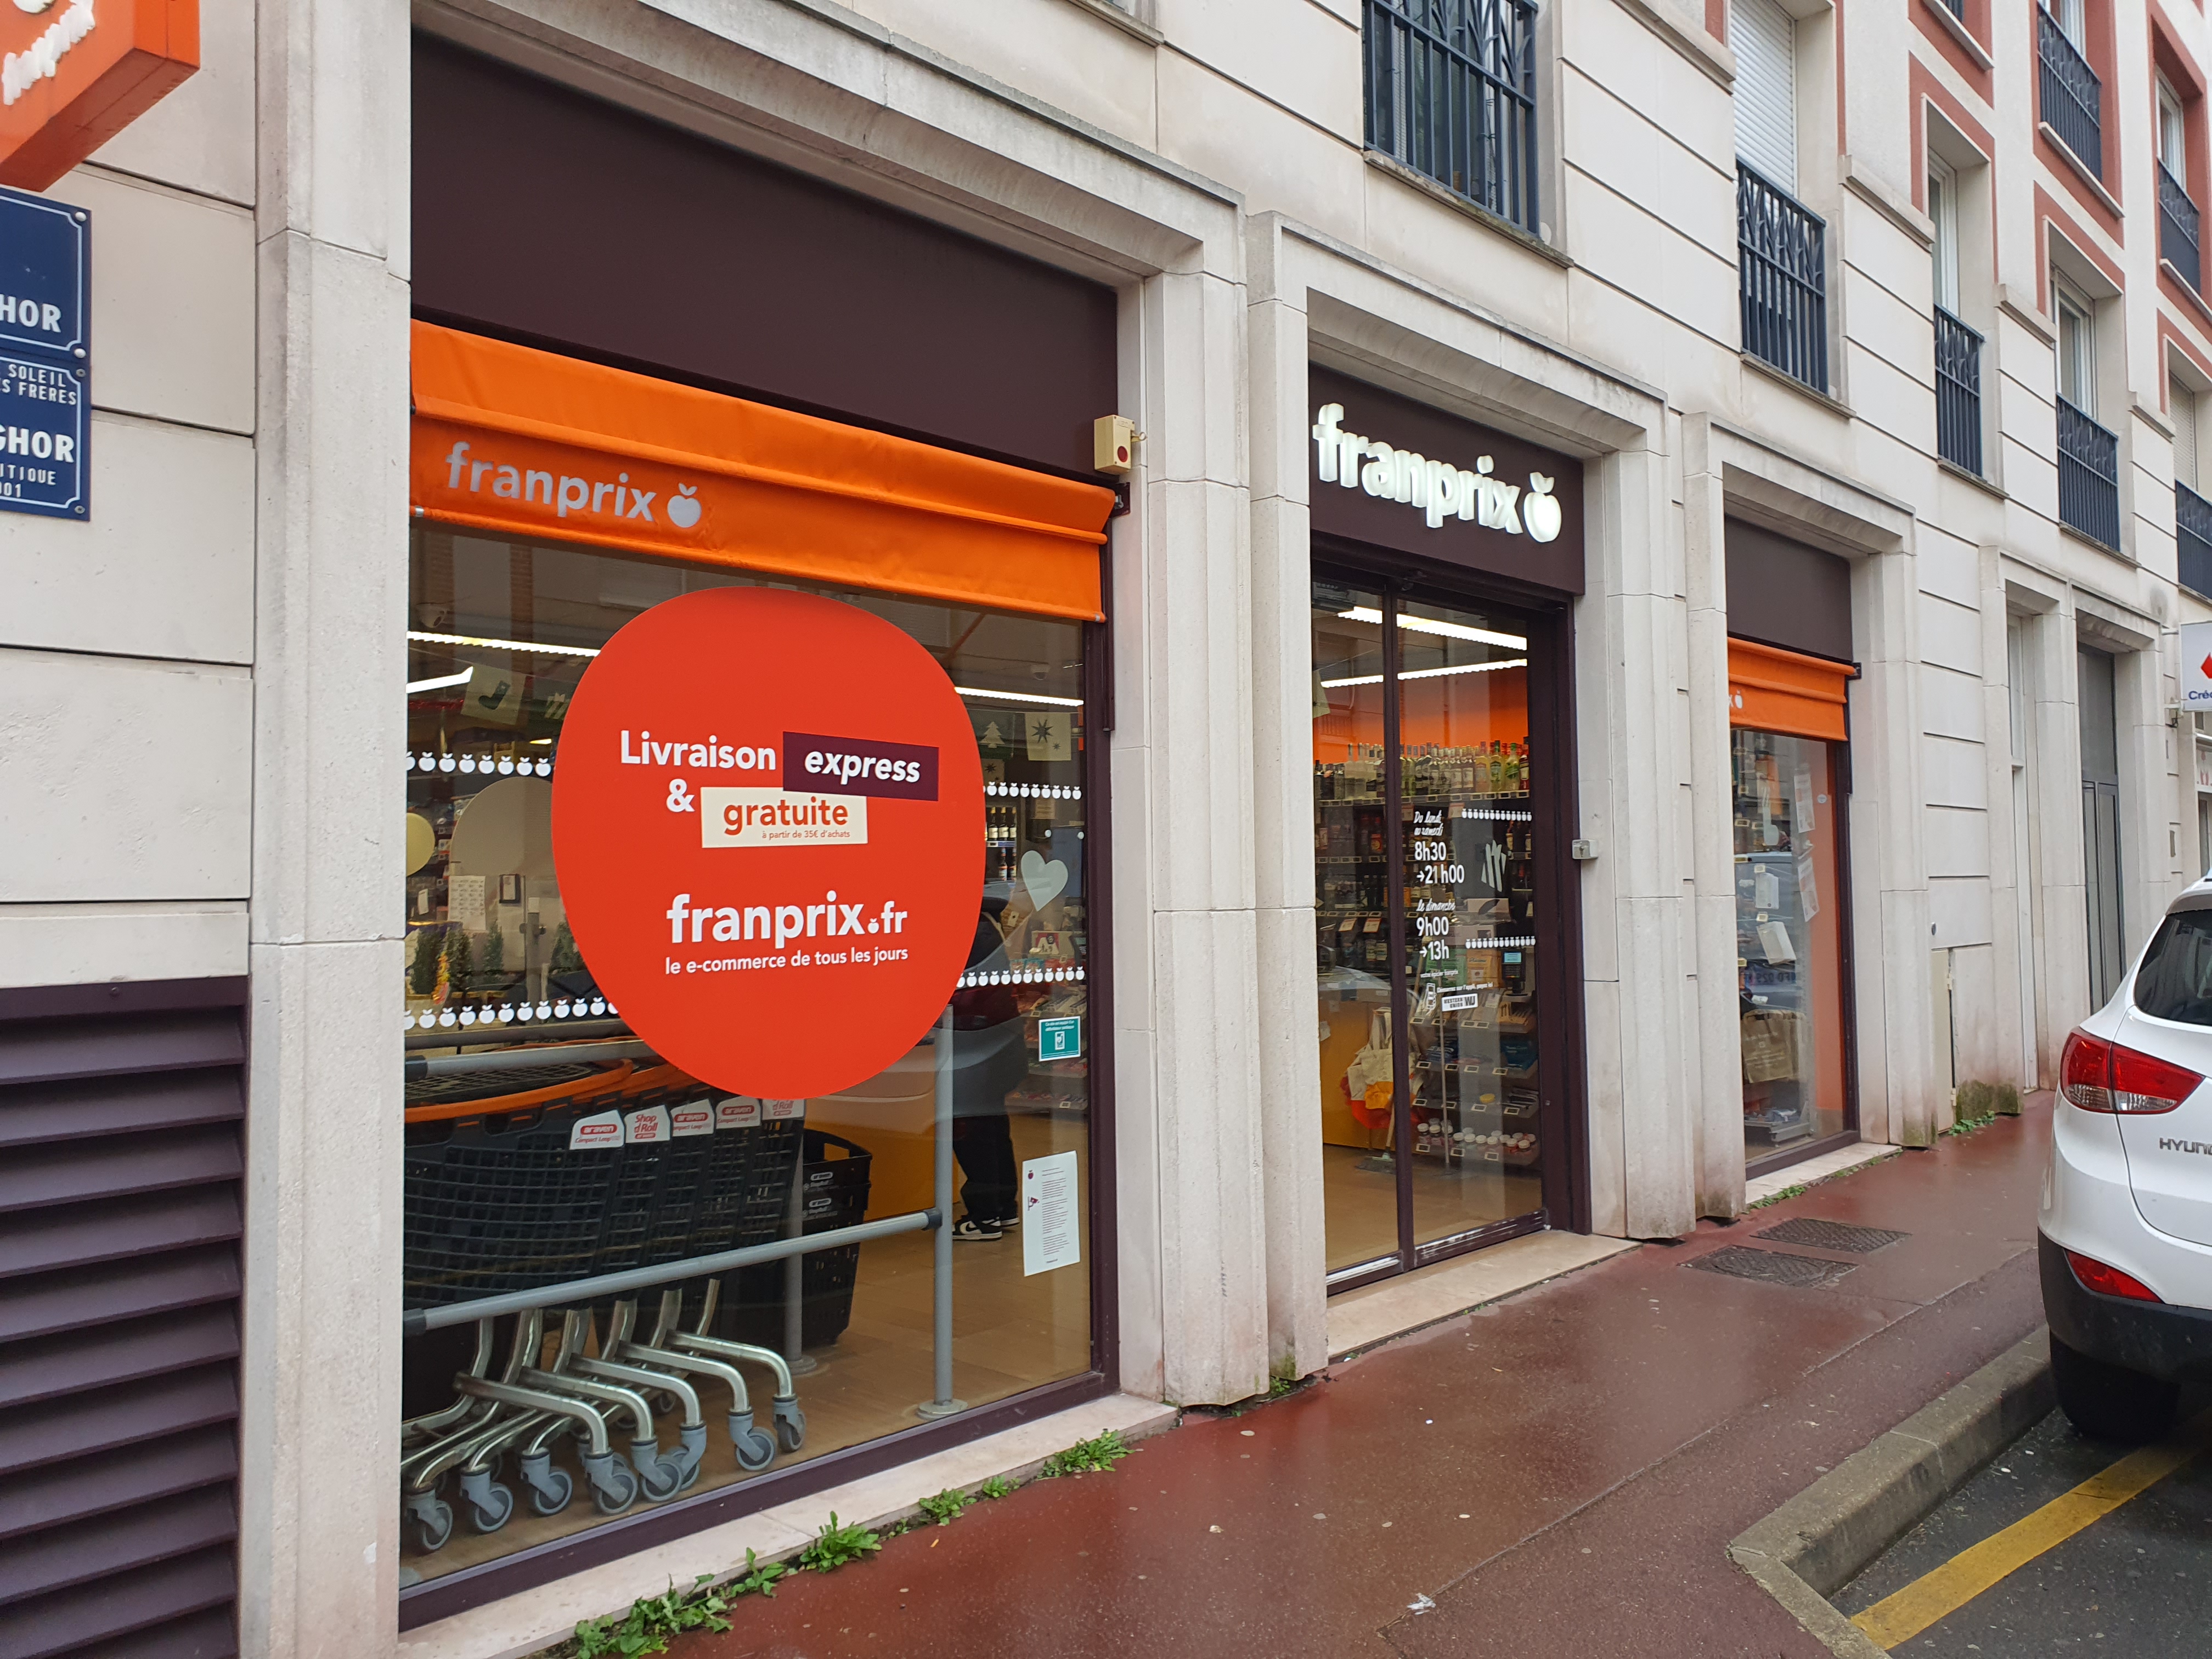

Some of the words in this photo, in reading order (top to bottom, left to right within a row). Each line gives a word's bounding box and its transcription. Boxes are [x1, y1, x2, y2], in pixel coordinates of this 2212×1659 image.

[8, 364, 66, 387] SOLEIL
[19, 382, 77, 405] FRERES
[1312, 403, 1523, 534] franprix
[445, 441, 657, 522] franprix
[620, 730, 776, 770] Livraison
[804, 750, 921, 785] express
[666, 778, 695, 813] &
[723, 796, 849, 836] gratuite
[769, 831, 790, 840] partir
[821, 830, 850, 838] d'achats
[1415, 841, 1446, 861] 8h30
[1417, 916, 1449, 936] 9h00
[665, 957, 681, 975] le
[686, 952, 786, 974] e-commerce
[791, 950, 810, 967] de
[815, 950, 847, 965] tous
[851, 947, 871, 963] les
[873, 947, 909, 967] jours
[1427, 939, 1449, 960] 13h
[635, 1114, 657, 1122] Shop
